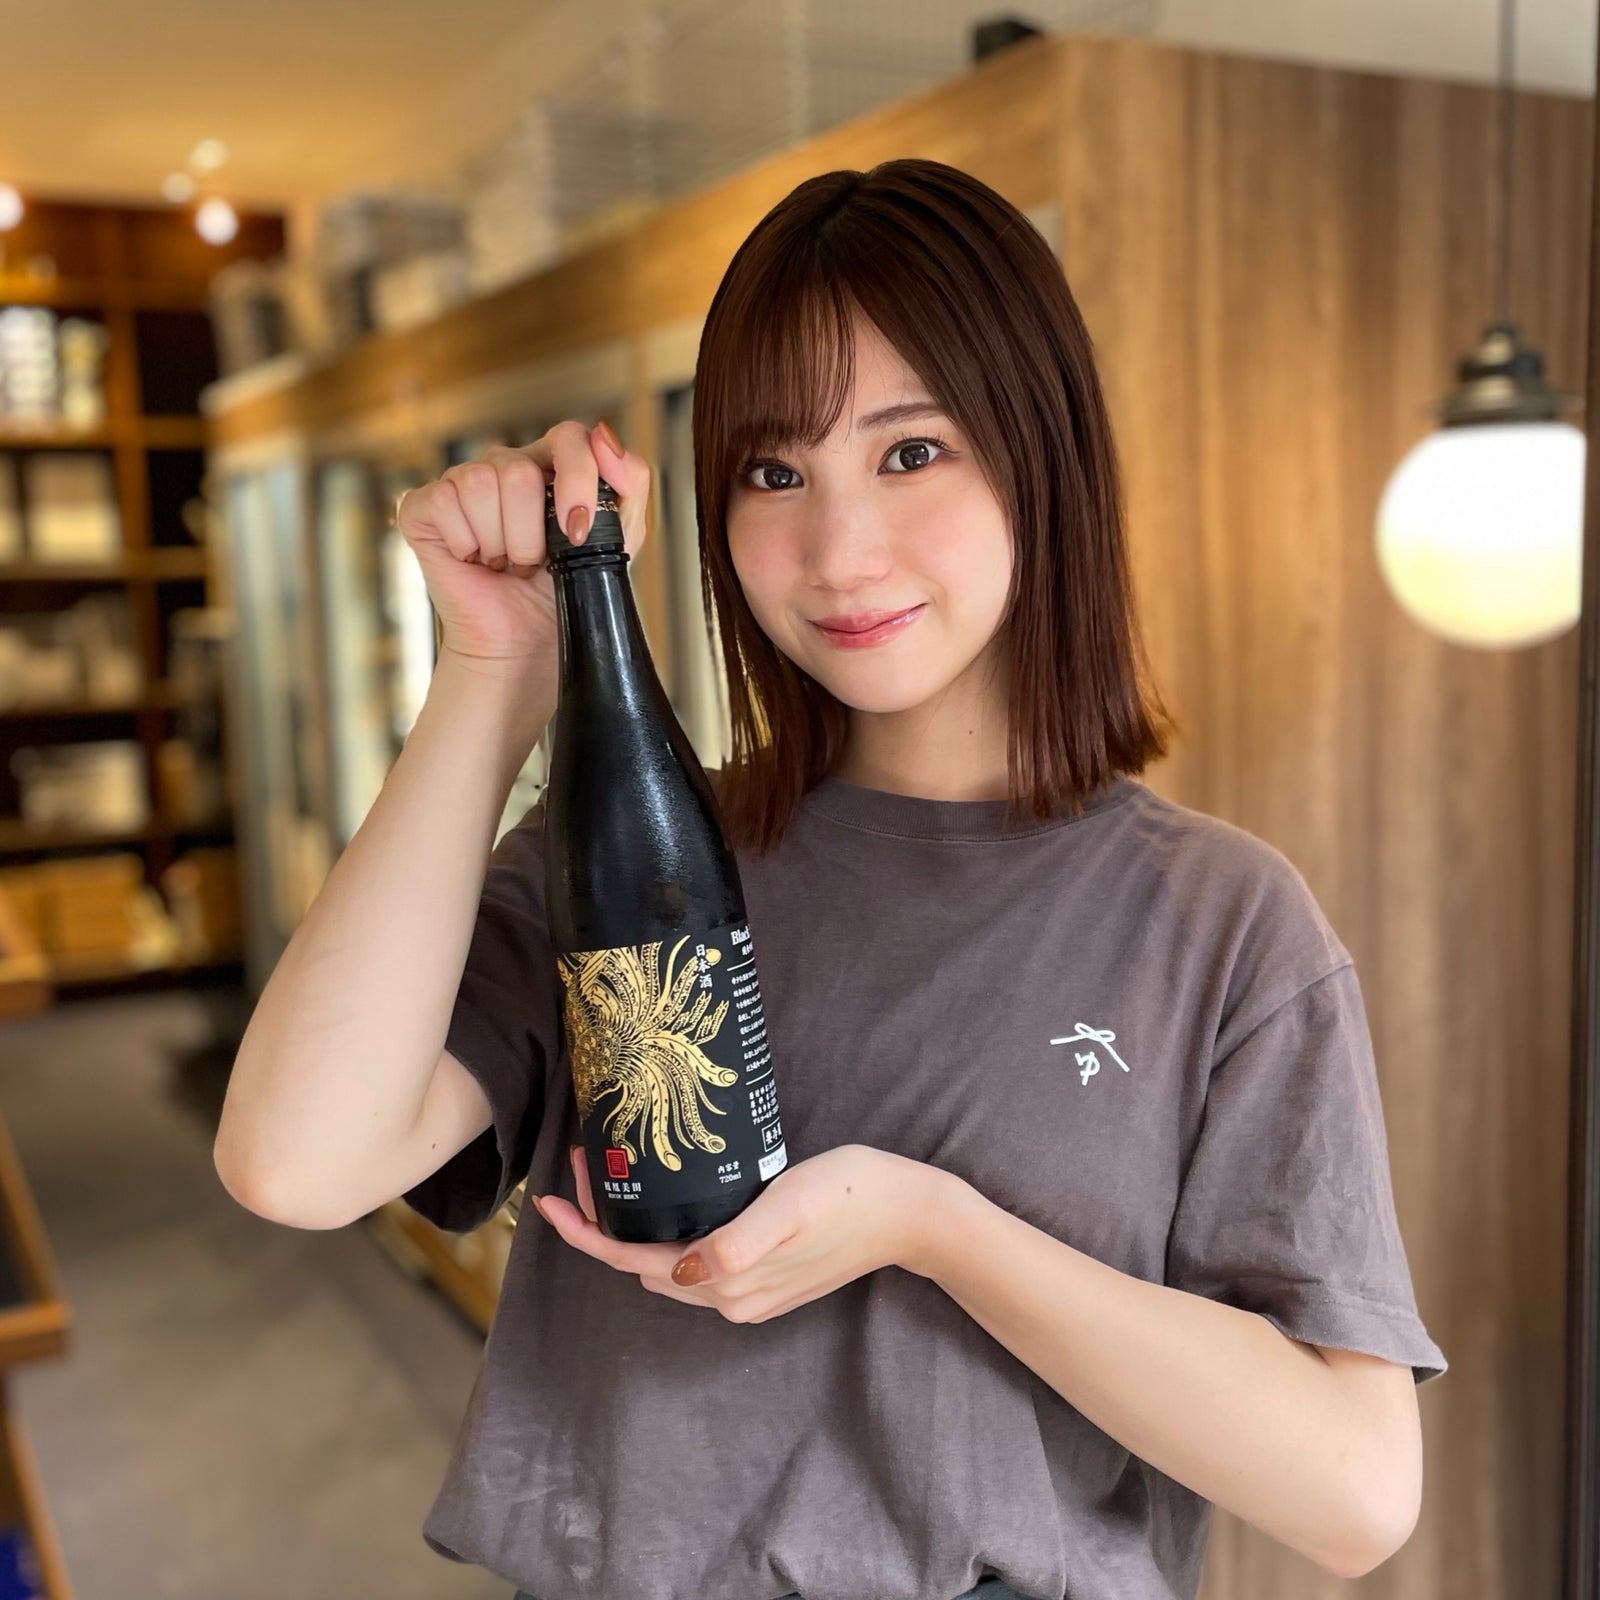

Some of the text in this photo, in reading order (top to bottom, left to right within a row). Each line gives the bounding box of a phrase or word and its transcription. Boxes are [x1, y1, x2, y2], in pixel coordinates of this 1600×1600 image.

[695, 943, 713, 989] 日本酒
[717, 1160, 740, 1174] 内容量
[719, 1171, 742, 1184] 720ml
